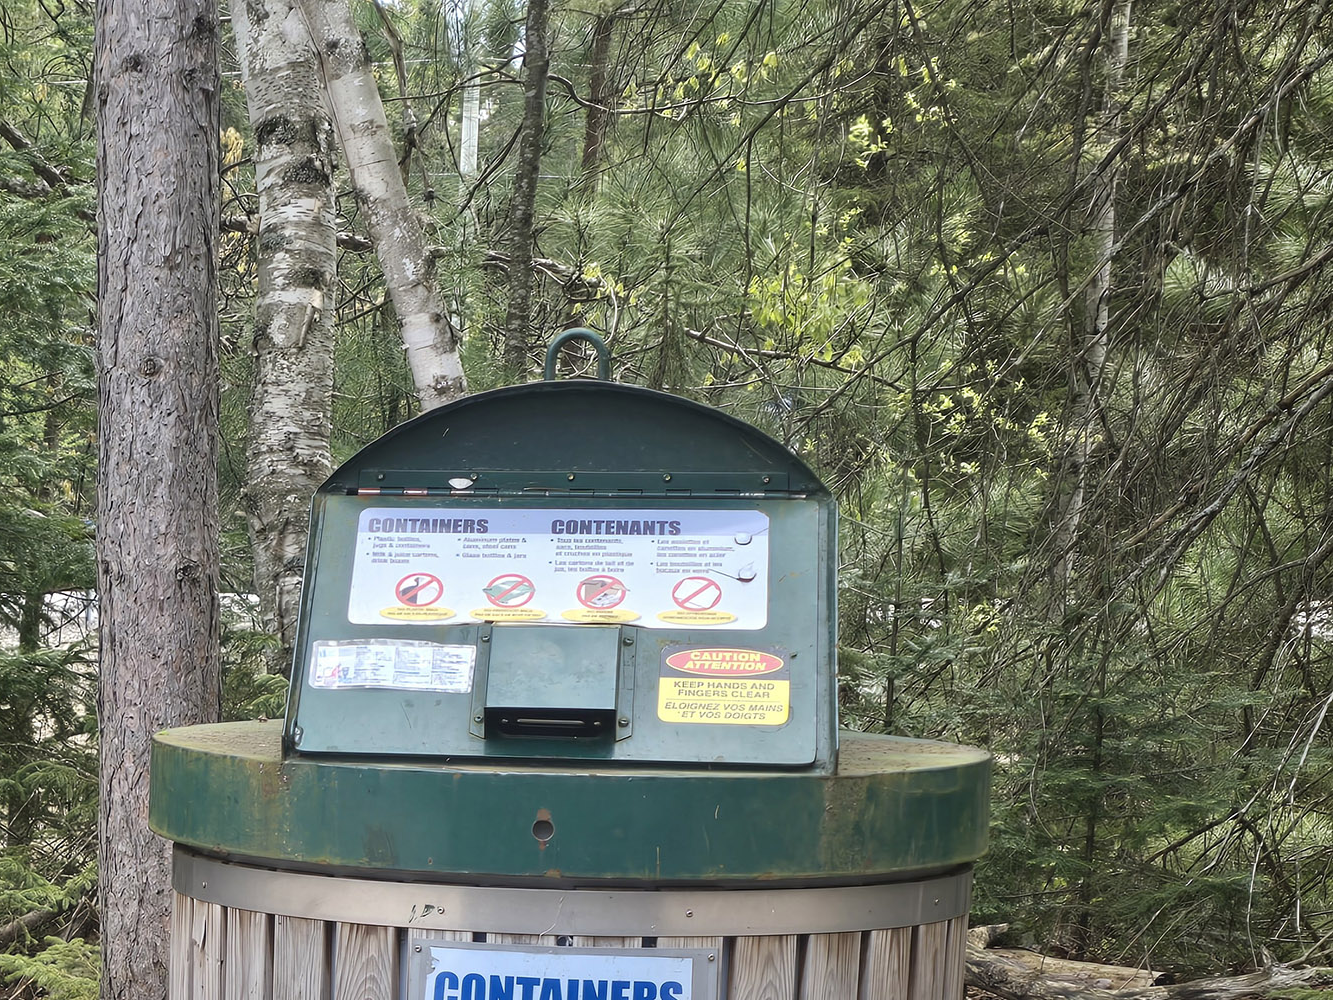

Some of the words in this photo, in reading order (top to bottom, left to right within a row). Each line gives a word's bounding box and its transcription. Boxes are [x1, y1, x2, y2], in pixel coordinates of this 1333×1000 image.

[368, 518, 489, 534] CONTAINERS
[551, 520, 681, 536] CONTENANTS
[690, 652, 761, 661] CAUTION
[684, 661, 767, 671] ATTENTION
[673, 681, 705, 689] KEEP
[707, 682, 747, 690] HANDS
[677, 689, 728, 697] FINGERS
[731, 691, 770, 699] CLEAR
[724, 712, 766, 720] DOIGTS
